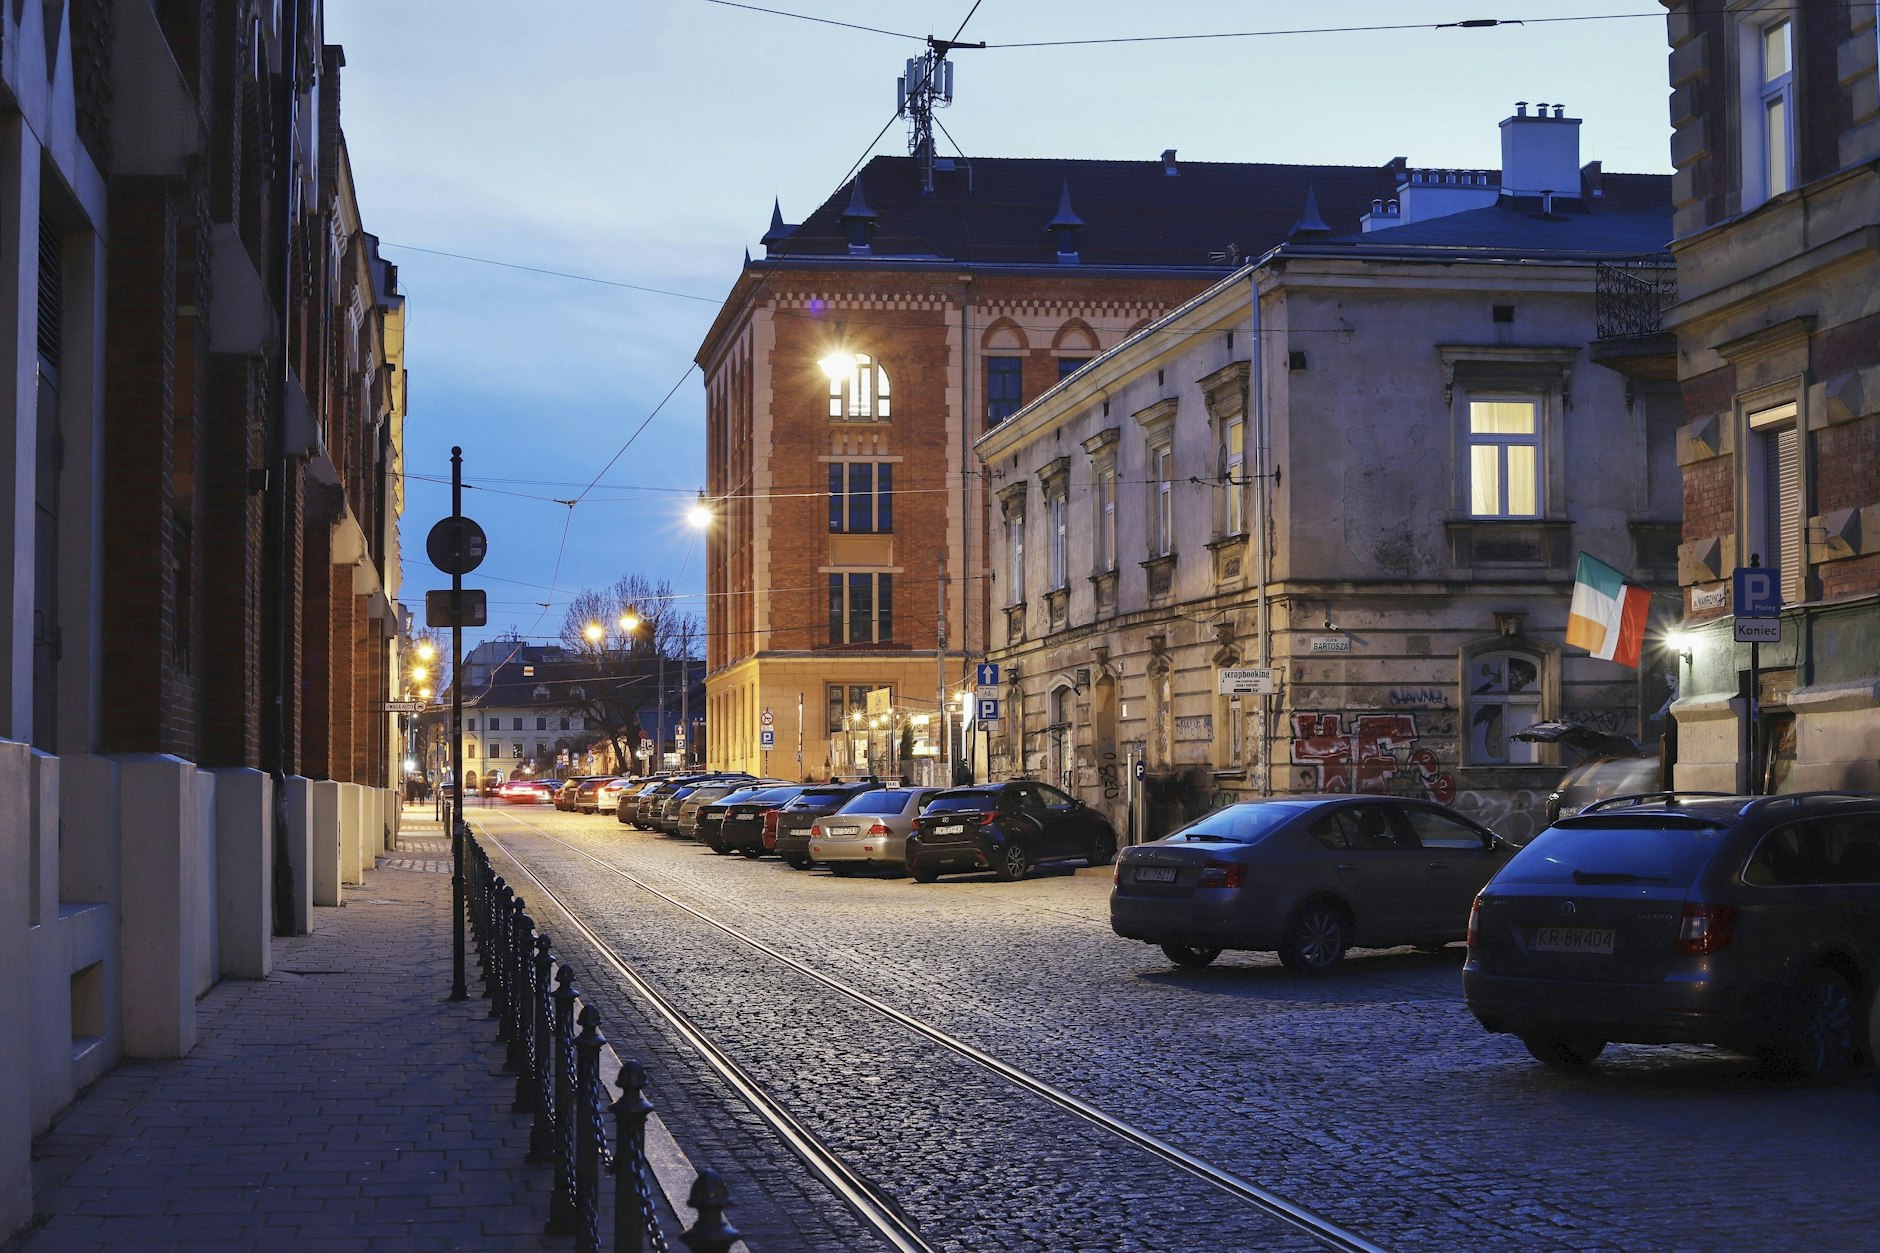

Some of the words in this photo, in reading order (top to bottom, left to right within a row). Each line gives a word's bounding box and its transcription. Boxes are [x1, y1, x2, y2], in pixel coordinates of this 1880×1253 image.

[1744, 573, 1770, 611] P
[1738, 625, 1777, 636] Koniec
[1313, 642, 1349, 651] BARTOSZA
[1224, 670, 1270, 679] scrapbooking
[982, 701, 994, 718] P
[1136, 766, 1144, 776] P
[1538, 927, 1560, 946] KR
[1564, 929, 1613, 948] 8W404
